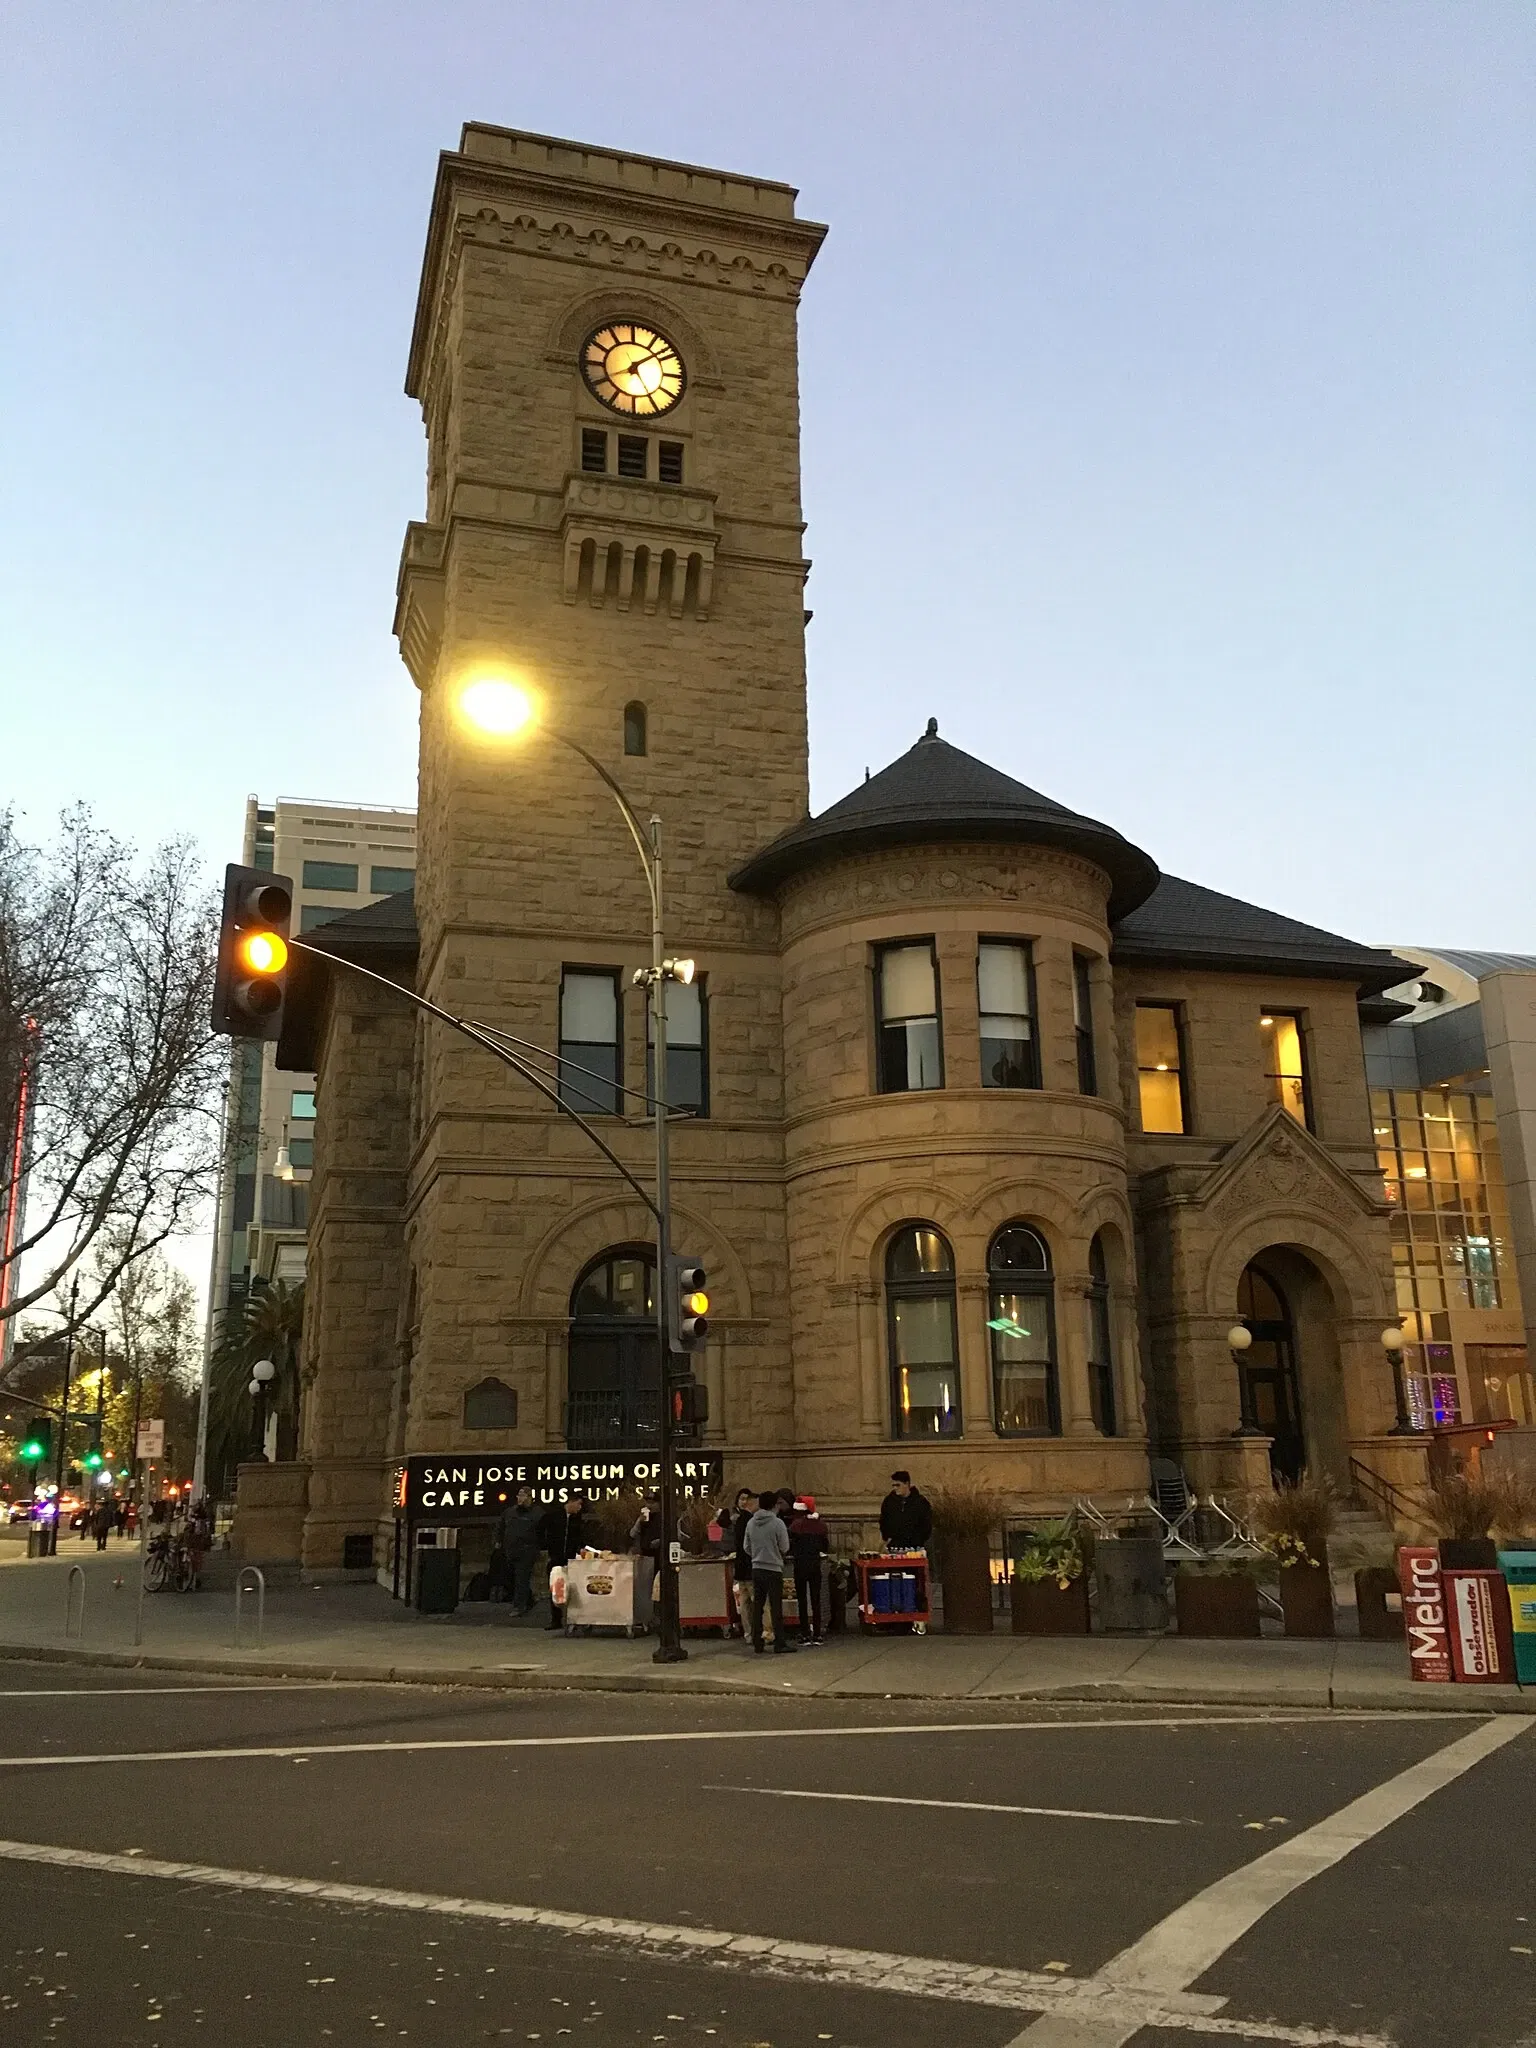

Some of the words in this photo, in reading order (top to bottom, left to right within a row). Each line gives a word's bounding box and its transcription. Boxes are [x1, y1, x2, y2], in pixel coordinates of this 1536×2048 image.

[423, 1469, 467, 1484] SAN
[475, 1466, 526, 1486] JOSE
[537, 1464, 624, 1481] MUSEUM
[633, 1463, 661, 1479] OF
[422, 1490, 485, 1507] CAFE
[531, 1486, 620, 1503] USUM
[635, 1485, 709, 1500] STRE
[1405, 1558, 1449, 1659] Metro
[1467, 1583, 1485, 1673] Observador
[1465, 1638, 1475, 1651] el
